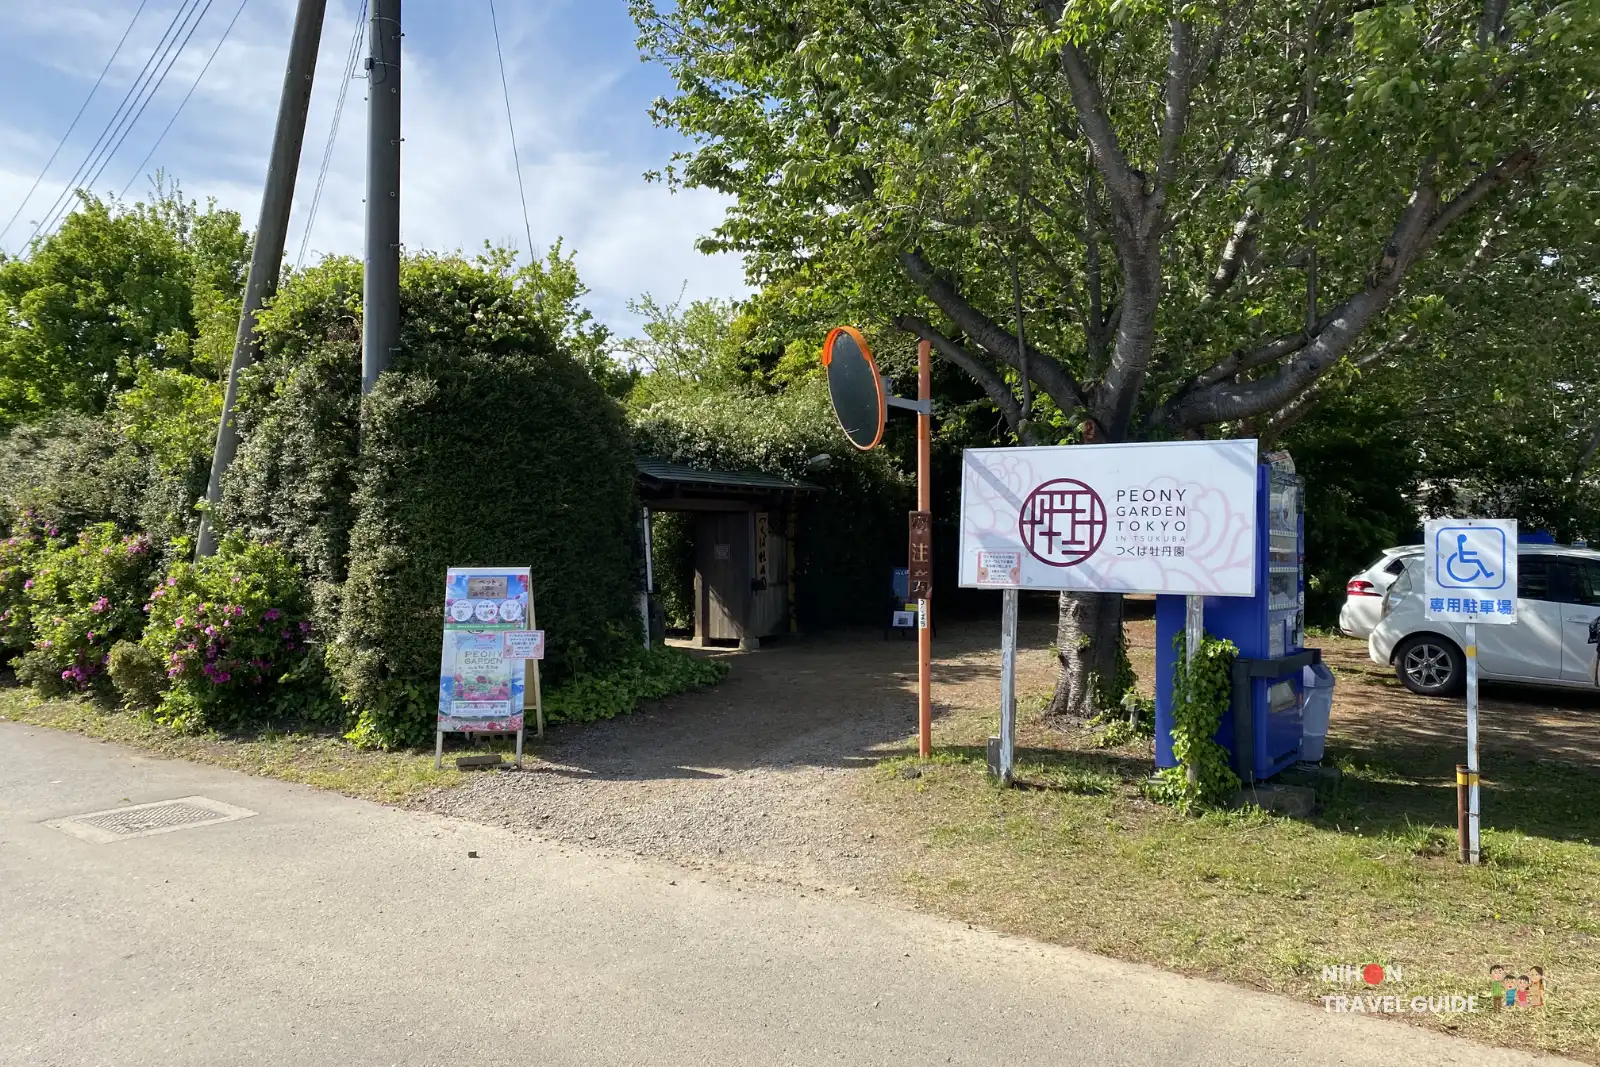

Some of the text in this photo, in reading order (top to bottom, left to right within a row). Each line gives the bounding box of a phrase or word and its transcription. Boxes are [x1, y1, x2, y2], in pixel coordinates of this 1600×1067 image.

[1116, 489, 1186, 502] PEONY
[1116, 506, 1186, 517] GARDEN
[1116, 520, 1186, 532] TOKYO
[1115, 546, 1185, 557] つくば牡丹園
[1430, 597, 1513, 615] 専用駐車場
[465, 650, 503, 658] PEONY
[464, 657, 503, 665] GARDEN
